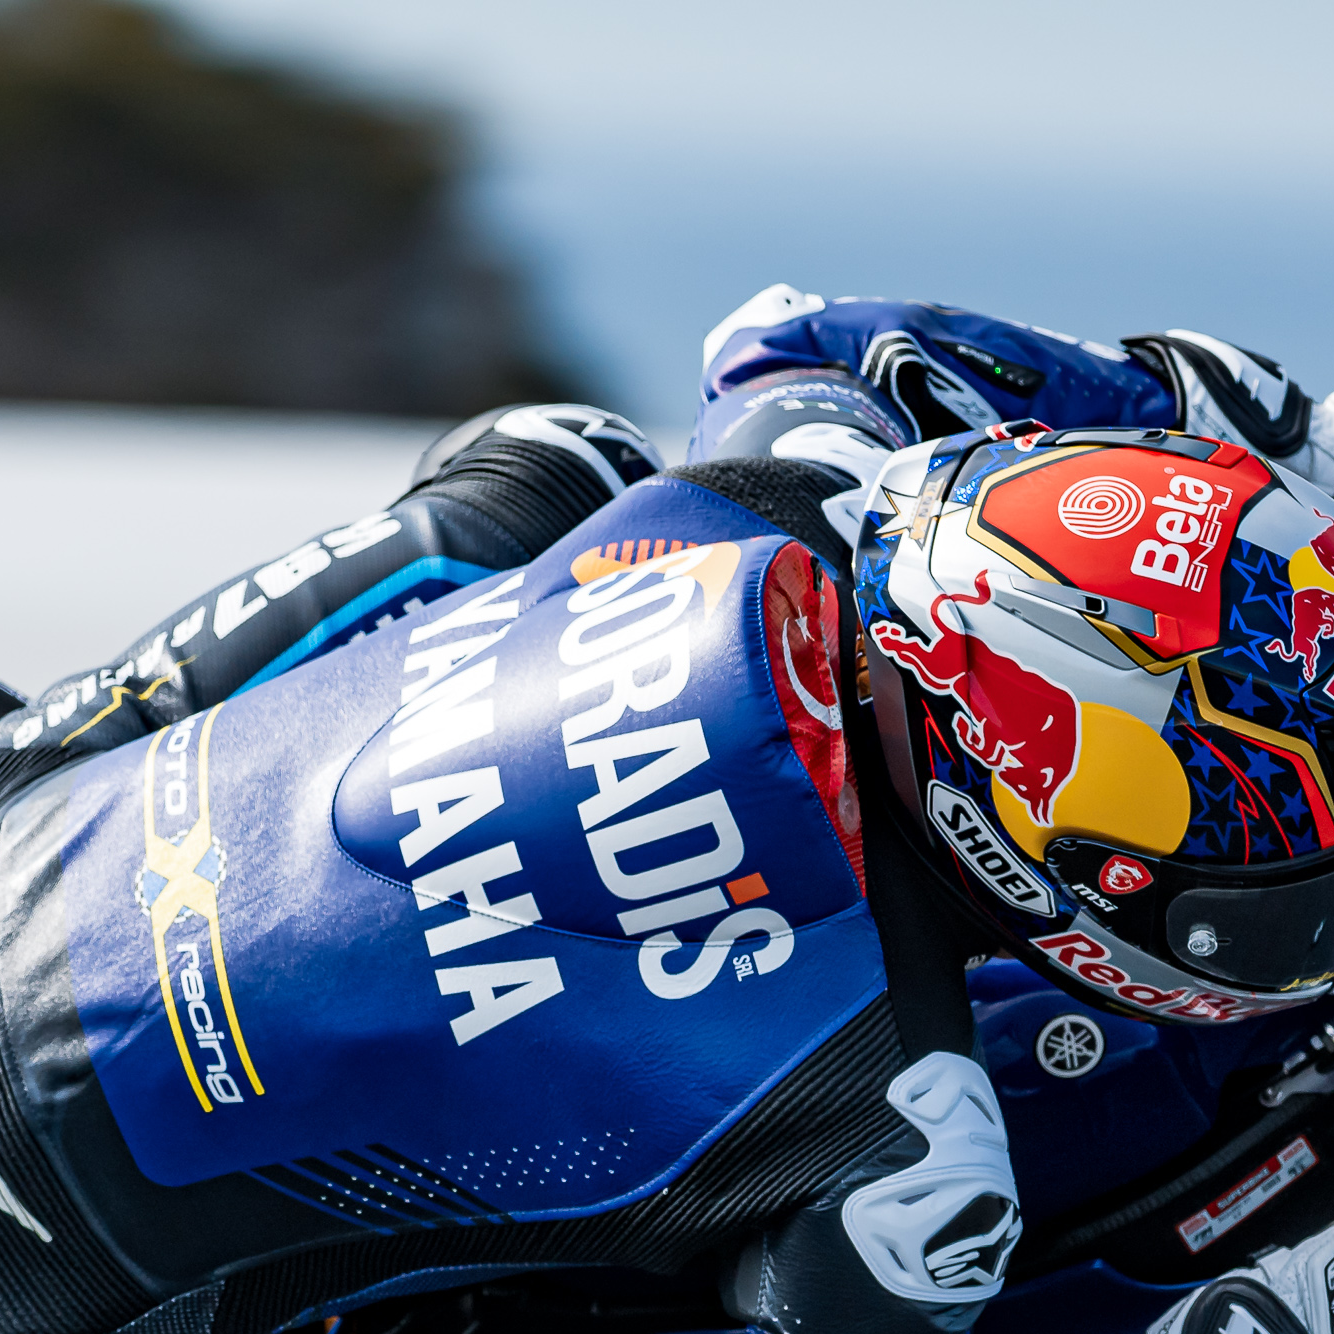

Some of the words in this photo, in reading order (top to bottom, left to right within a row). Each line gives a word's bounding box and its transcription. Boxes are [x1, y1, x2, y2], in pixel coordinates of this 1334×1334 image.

[213, 511, 402, 640] S97
[1130, 475, 1213, 587] Beta
[388, 571, 565, 1047] YAMAHA
[937, 803, 1042, 903] SHOEI
[1071, 883, 1119, 913] msi
[176, 942, 244, 1103] racing
[732, 954, 755, 982] SRL
